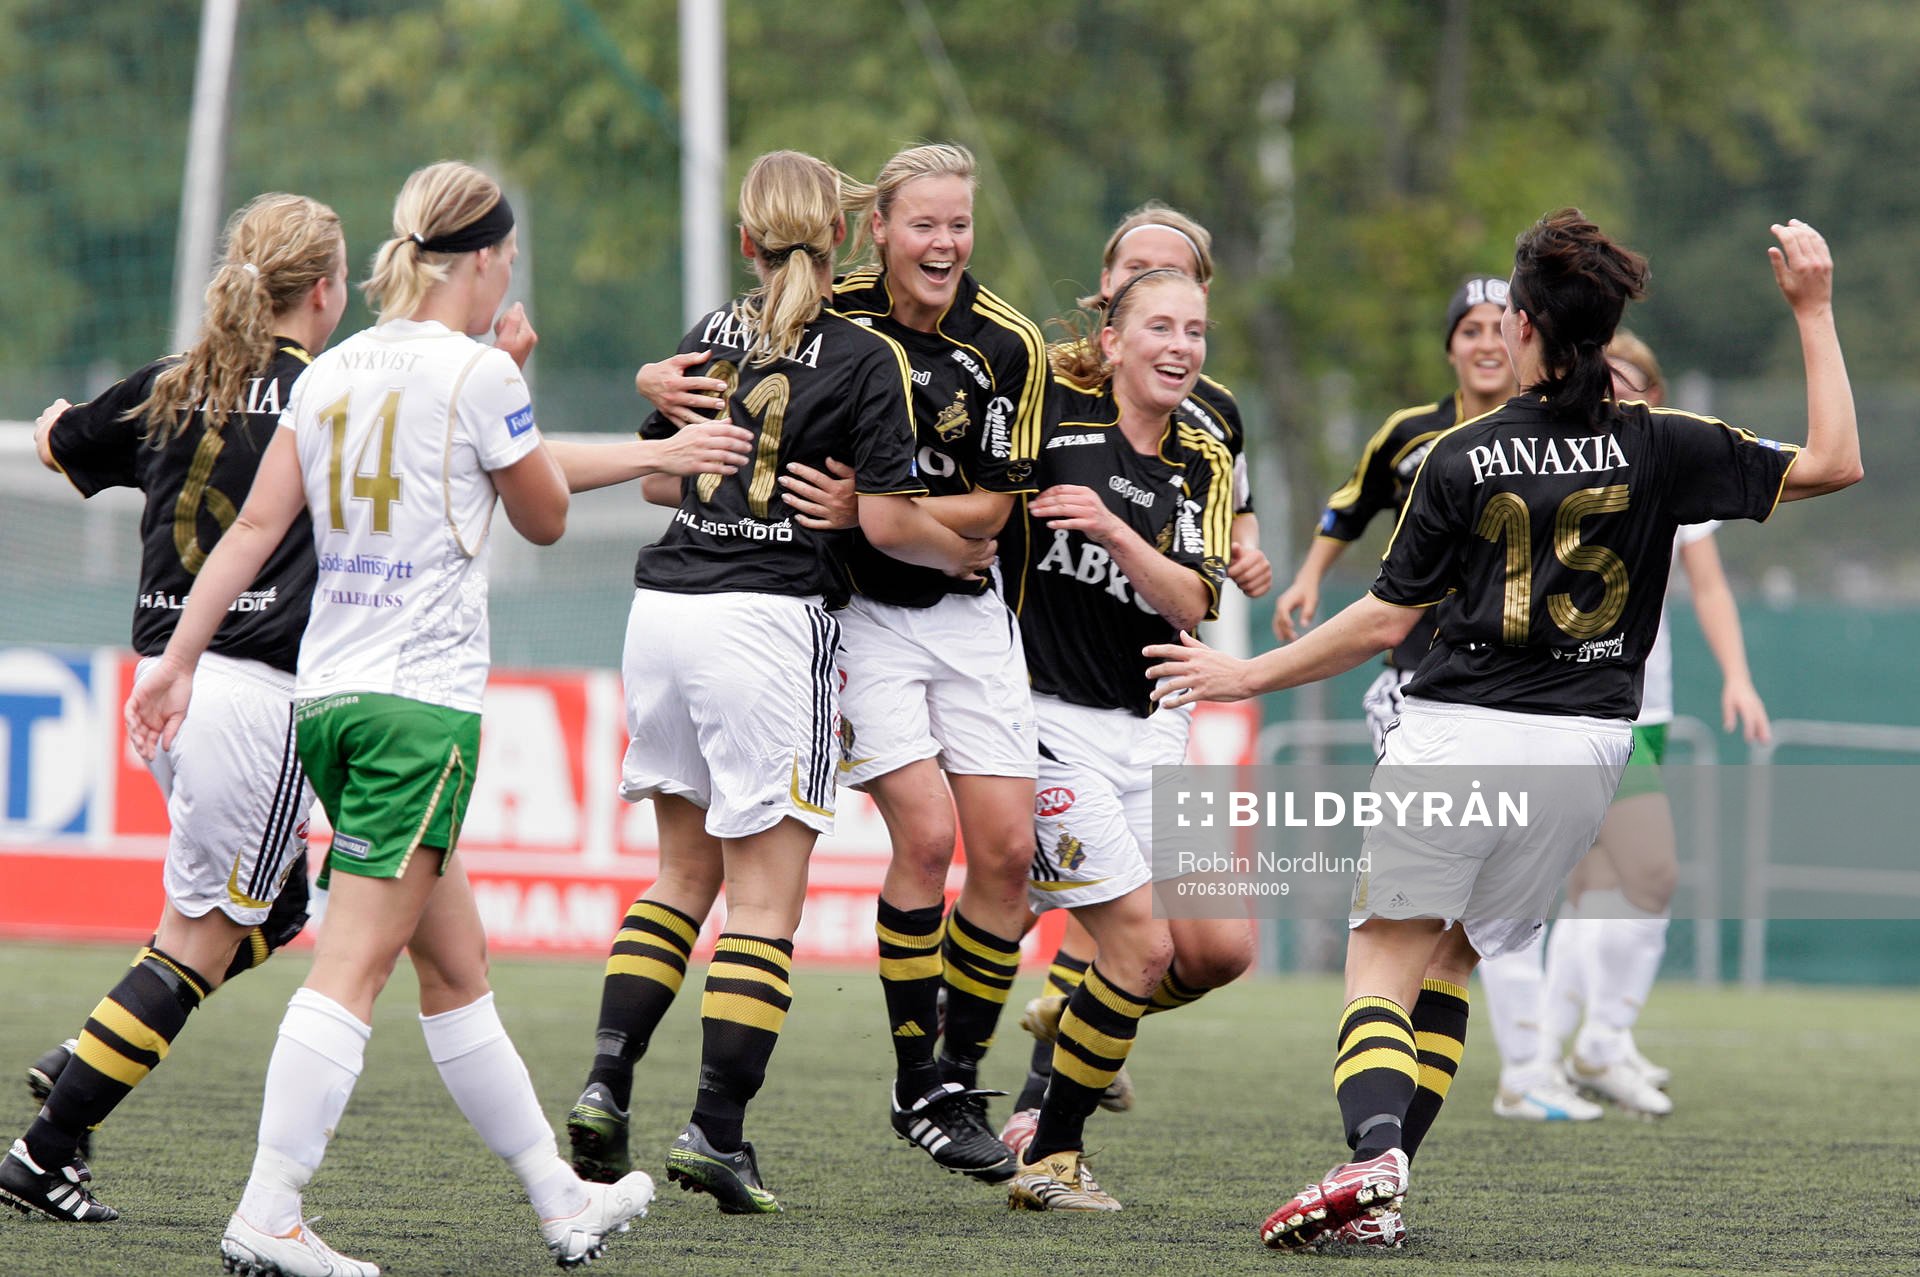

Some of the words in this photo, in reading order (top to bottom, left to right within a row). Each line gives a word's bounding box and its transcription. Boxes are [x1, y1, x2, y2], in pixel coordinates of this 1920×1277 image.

[317, 388, 403, 536] 14
[1467, 432, 1629, 485] PANAXIA
[1037, 529, 1161, 615] ÅBR
[1474, 484, 1630, 645] 15
